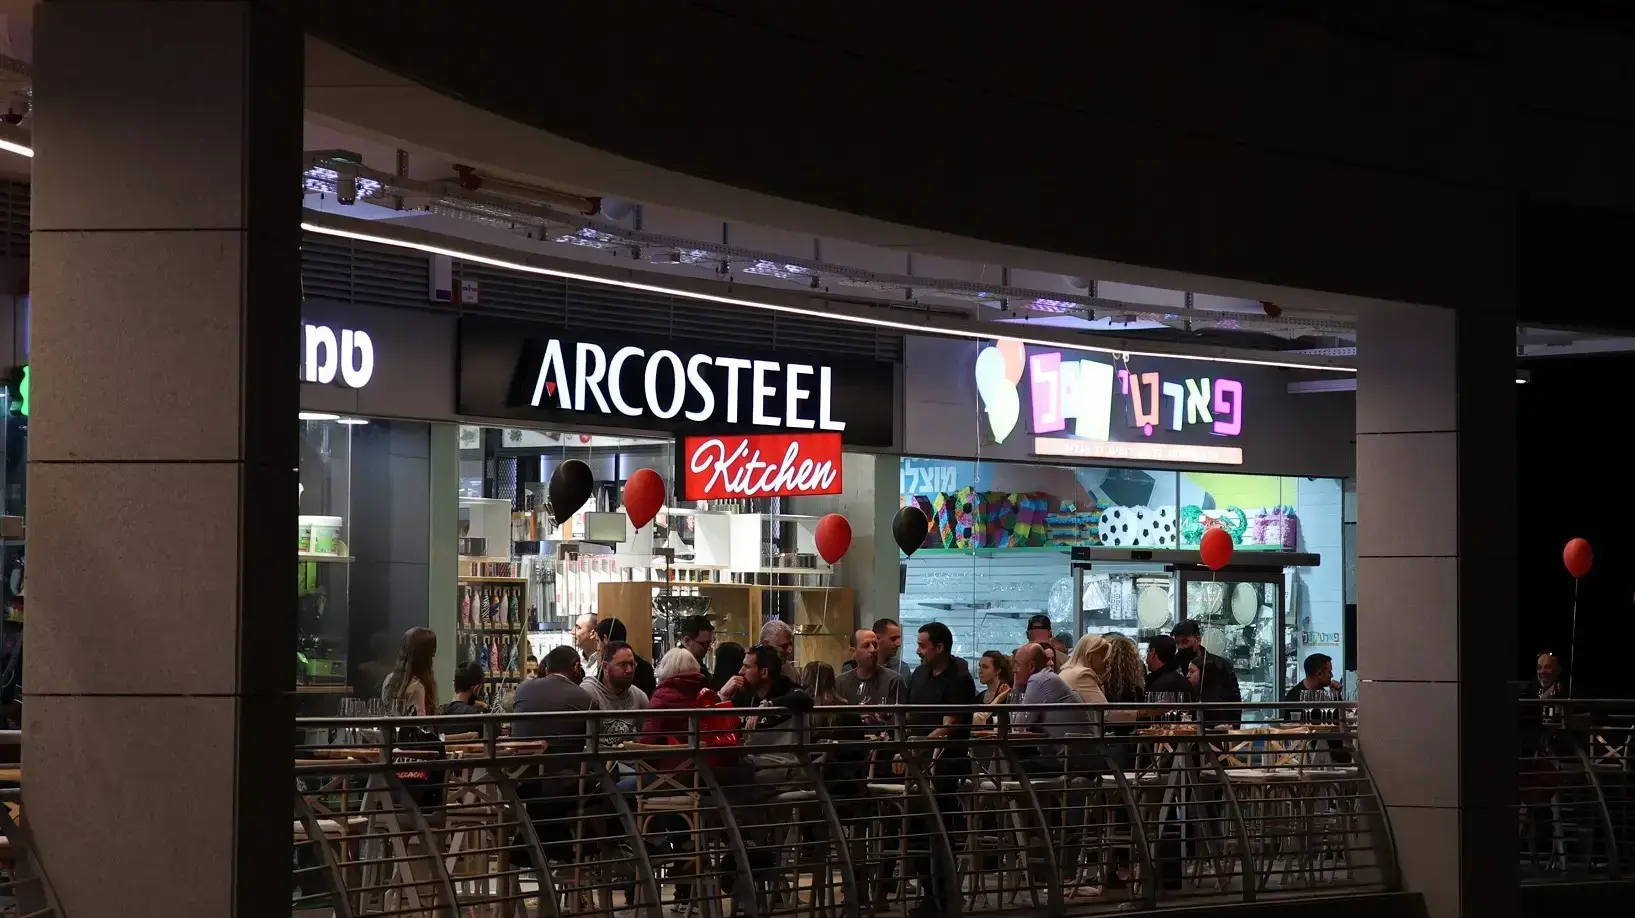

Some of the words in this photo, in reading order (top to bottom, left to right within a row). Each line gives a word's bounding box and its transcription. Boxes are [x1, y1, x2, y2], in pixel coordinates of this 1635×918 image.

[300, 324, 374, 389] טמ
[530, 338, 847, 431] ARCOSTEEL
[690, 438, 837, 497] Kitchen
